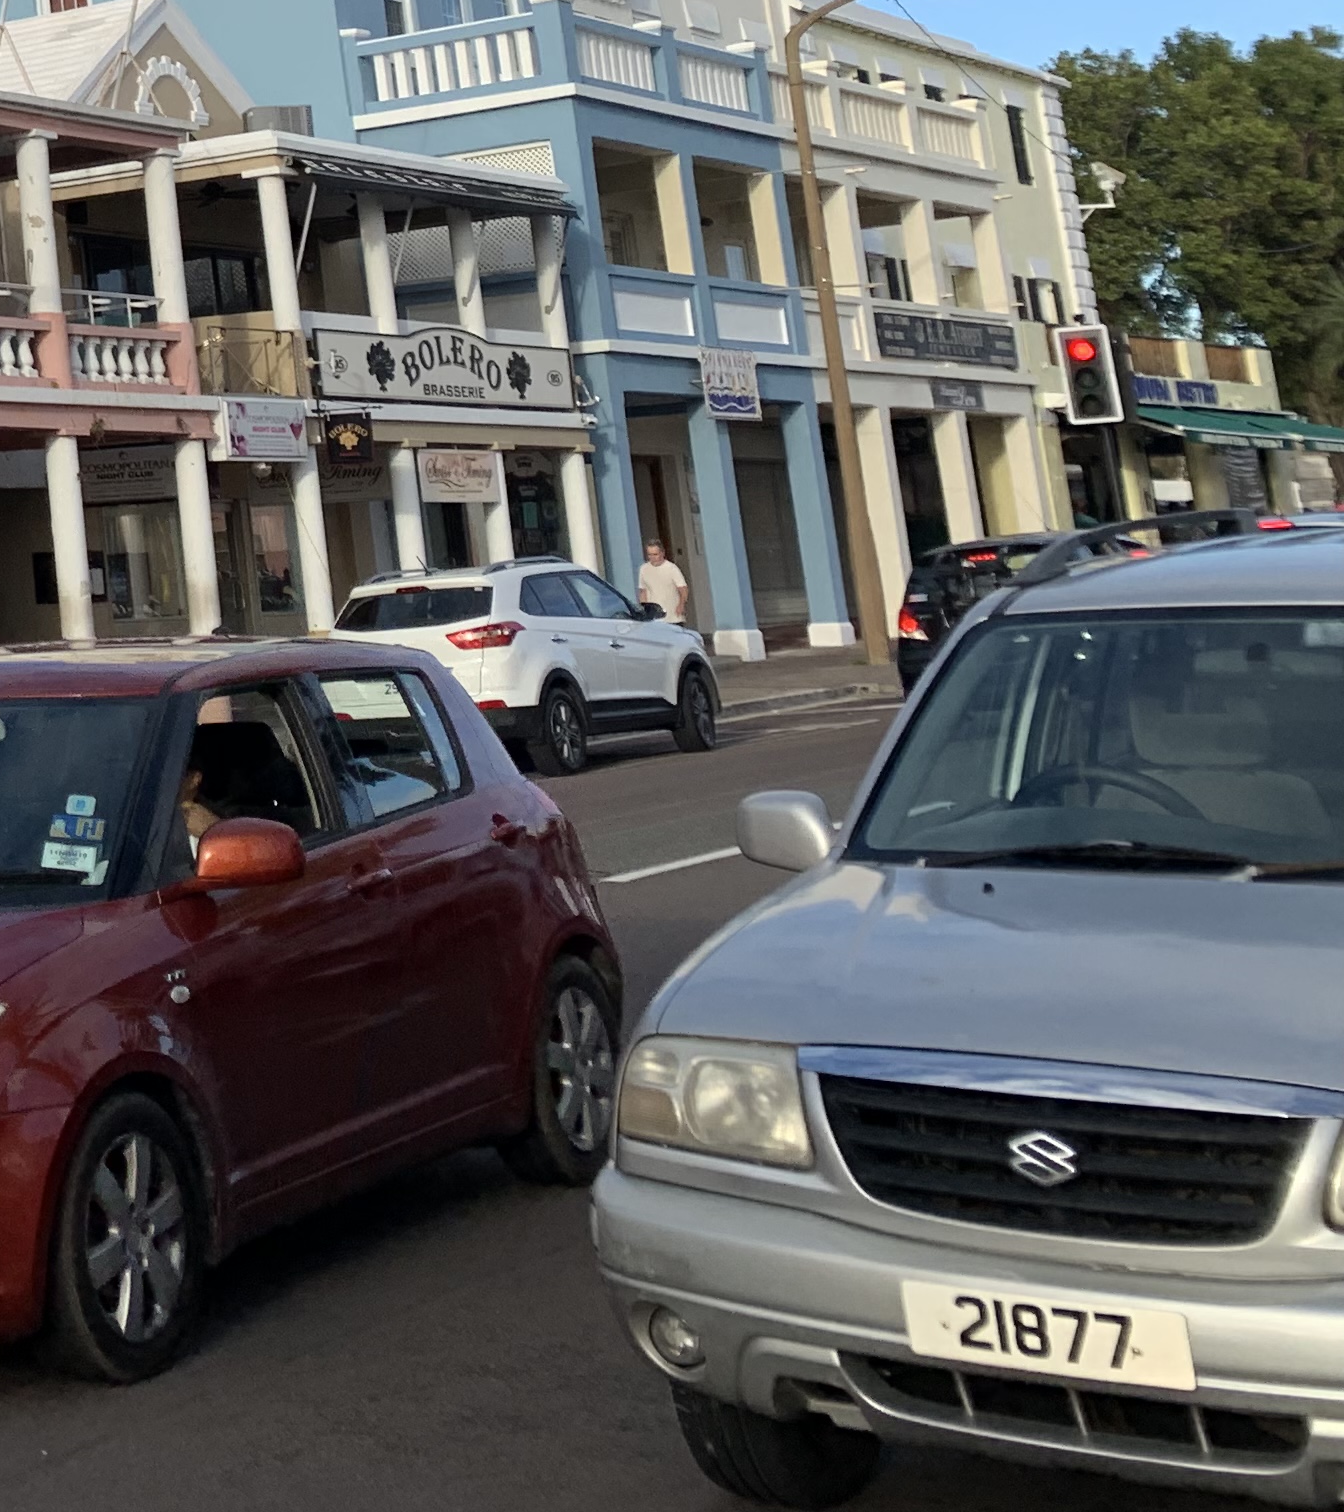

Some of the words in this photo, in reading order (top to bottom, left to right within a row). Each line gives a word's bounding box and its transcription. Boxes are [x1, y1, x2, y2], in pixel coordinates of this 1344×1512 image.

[401, 335, 502, 392] BOLERO
[422, 383, 486, 399] BRASSERIE
[96, 472, 125, 480] NIGHT
[127, 470, 154, 479] CLUB
[954, 1295, 1133, 1370] 21877
